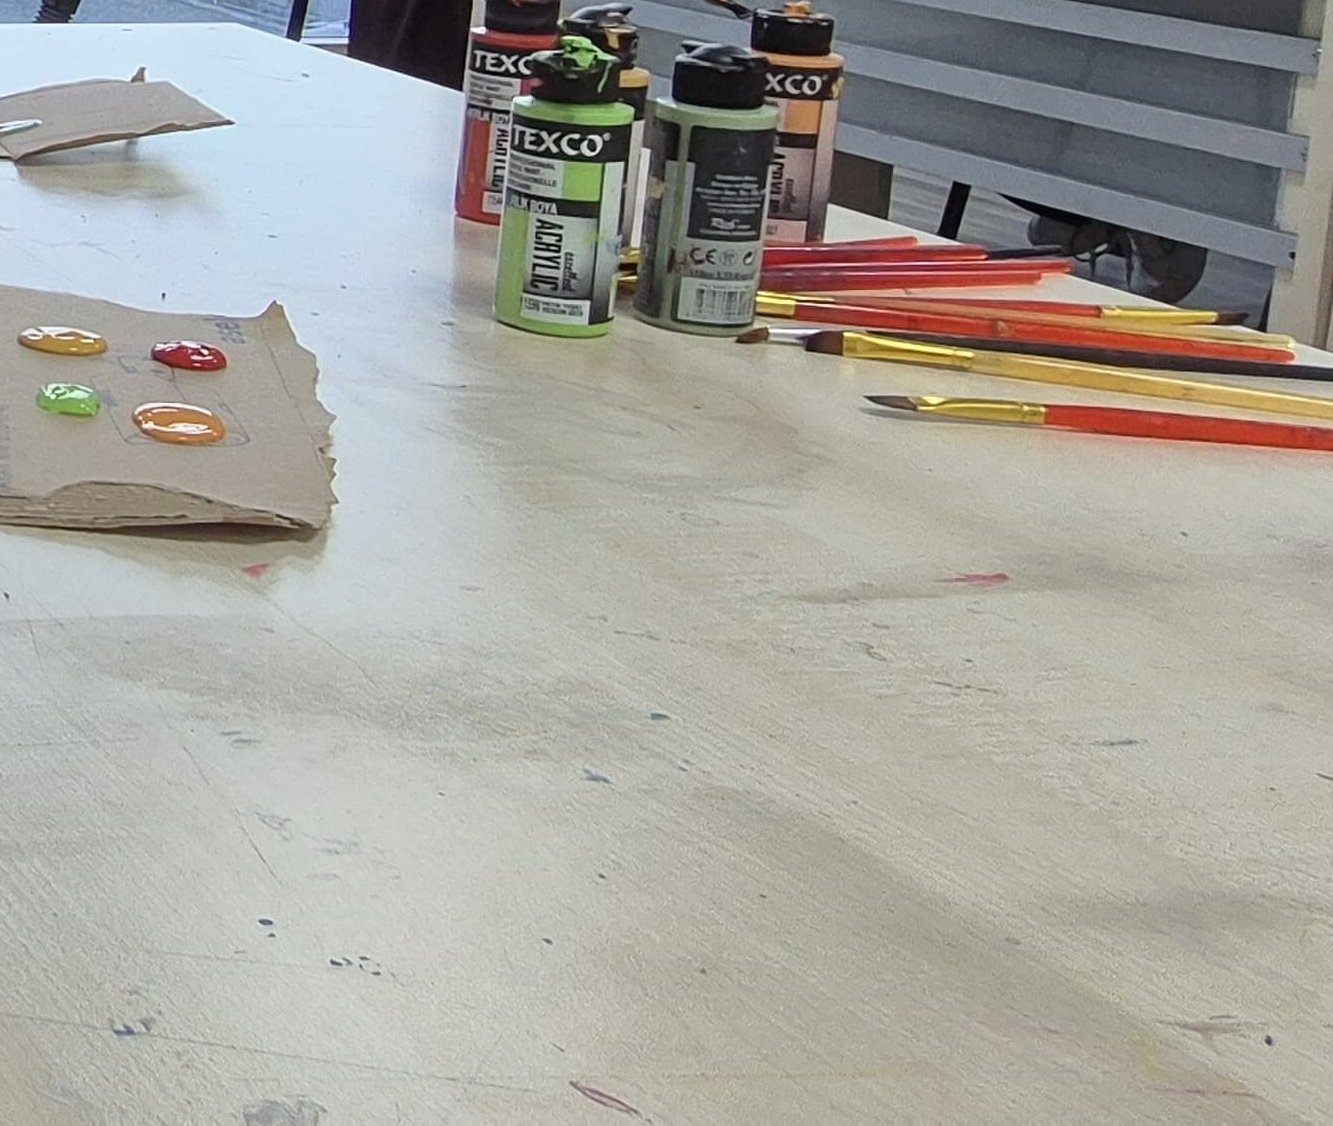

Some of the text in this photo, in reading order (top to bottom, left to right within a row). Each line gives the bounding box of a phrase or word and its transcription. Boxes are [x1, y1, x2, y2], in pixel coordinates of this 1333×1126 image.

[473, 49, 534, 75] TEXC
[765, 72, 823, 96] XCO
[512, 123, 604, 158] TEXCO
[530, 199, 558, 215] BOYA
[530, 217, 564, 291] ACRYLIC
